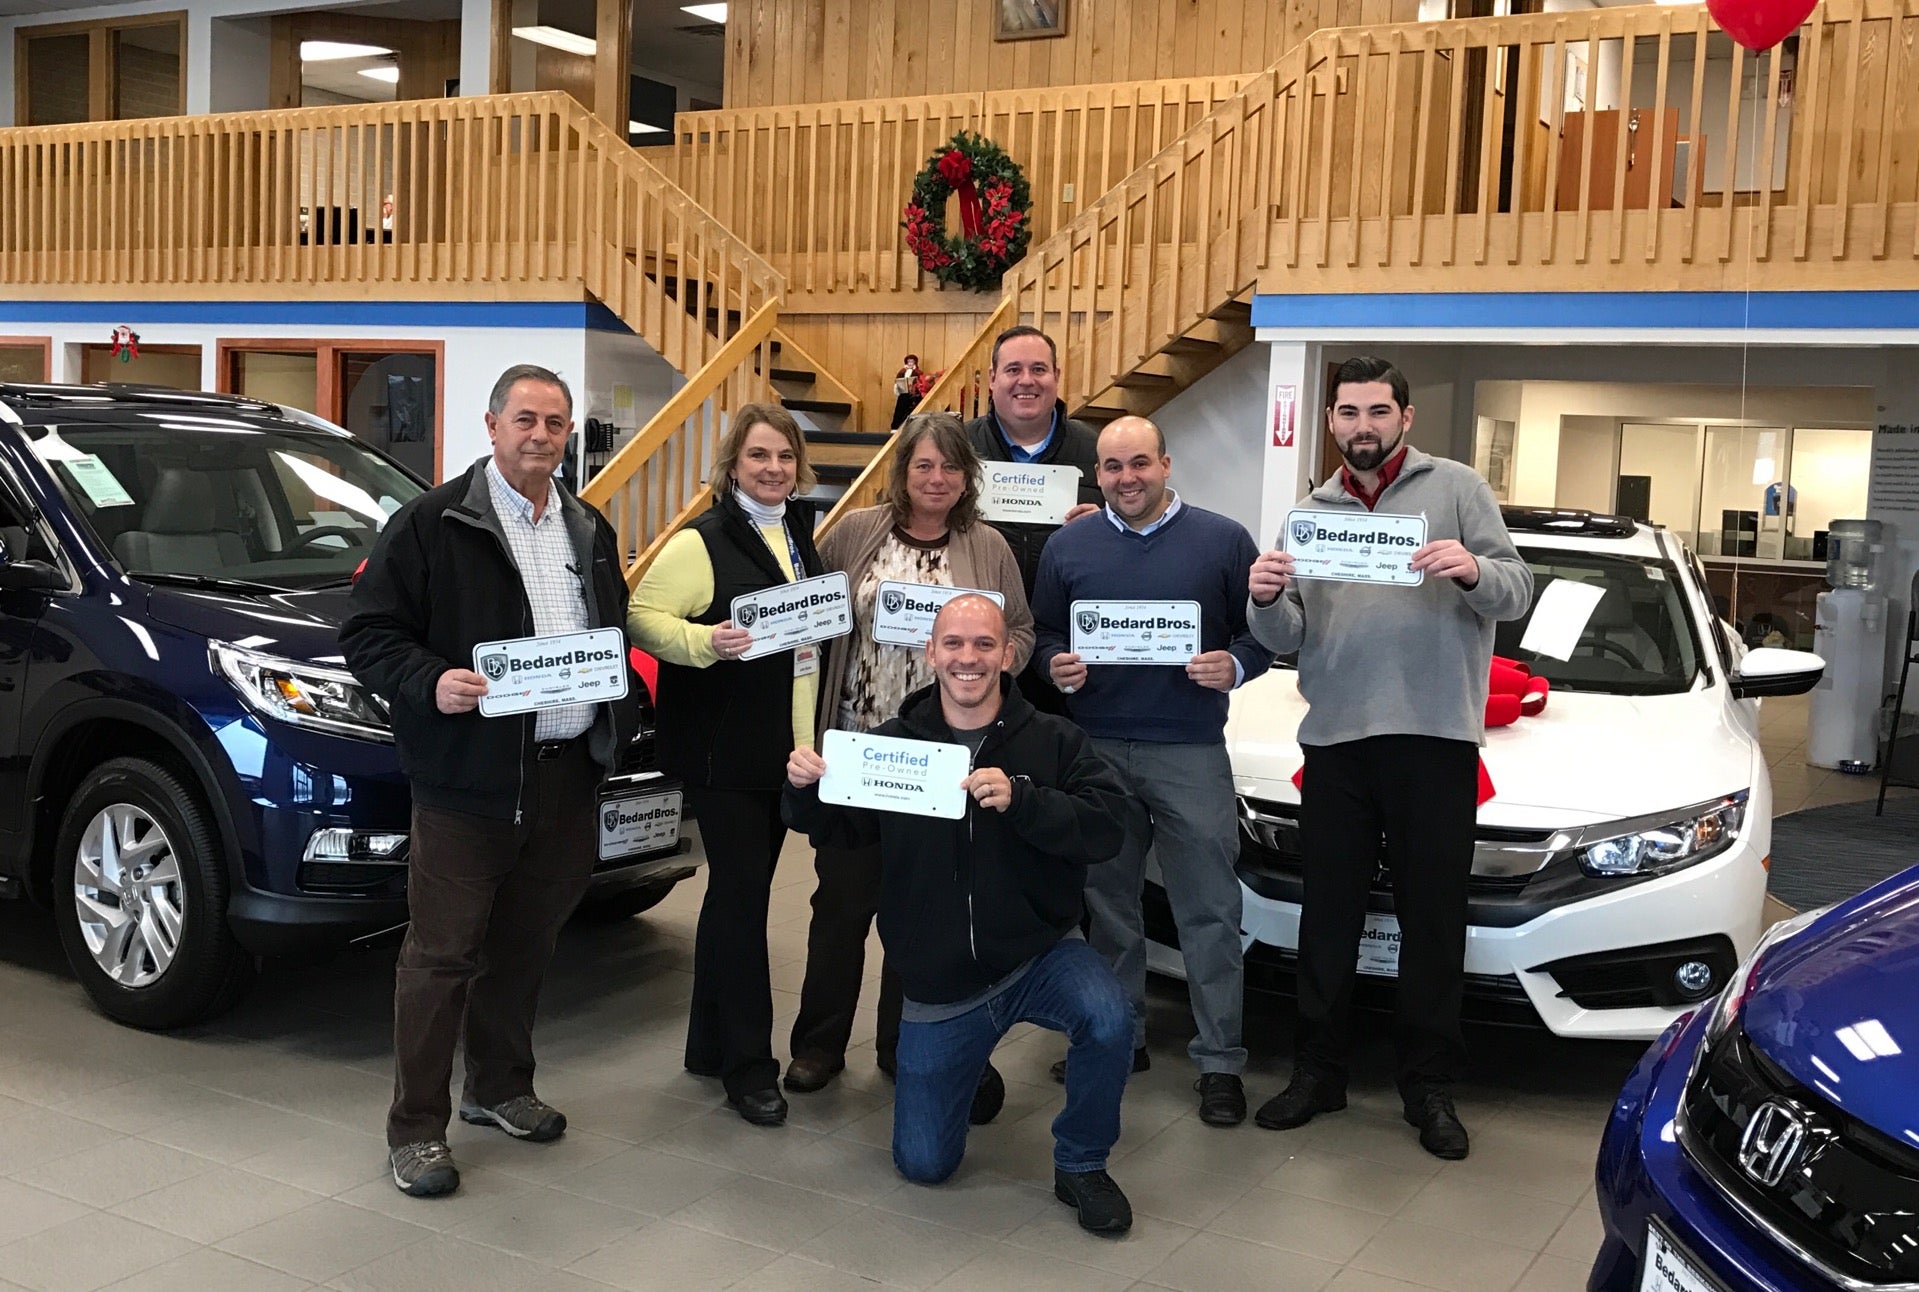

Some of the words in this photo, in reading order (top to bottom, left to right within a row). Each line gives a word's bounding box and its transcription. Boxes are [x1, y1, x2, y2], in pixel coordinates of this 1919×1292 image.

[1279, 390, 1292, 400] FIRE
[1878, 424, 1906, 434] Made
[992, 472, 1045, 486] Certified
[992, 484, 1044, 494] Pre-Owned
[1002, 498, 1042, 506] HONDA
[1316, 528, 1376, 544] Bedard
[1378, 532, 1420, 547] Bros.
[1376, 562, 1398, 571] Jeep
[760, 597, 808, 618] Bedard
[810, 591, 846, 606] Bros.
[905, 598, 942, 613] Beda
[814, 619, 832, 628] Jeep
[1100, 617, 1154, 629] Bedard
[1156, 618, 1196, 629] Bros.
[510, 652, 572, 672] Bedard
[574, 649, 619, 664] Bros.
[578, 680, 600, 689] Jeep
[863, 748, 928, 767] Certified
[862, 761, 927, 777] Pre-Owned
[874, 780, 924, 792] HONDA
[620, 810, 654, 825] Bedard
[654, 808, 678, 819] Bros.
[1360, 928, 1401, 942] edard
